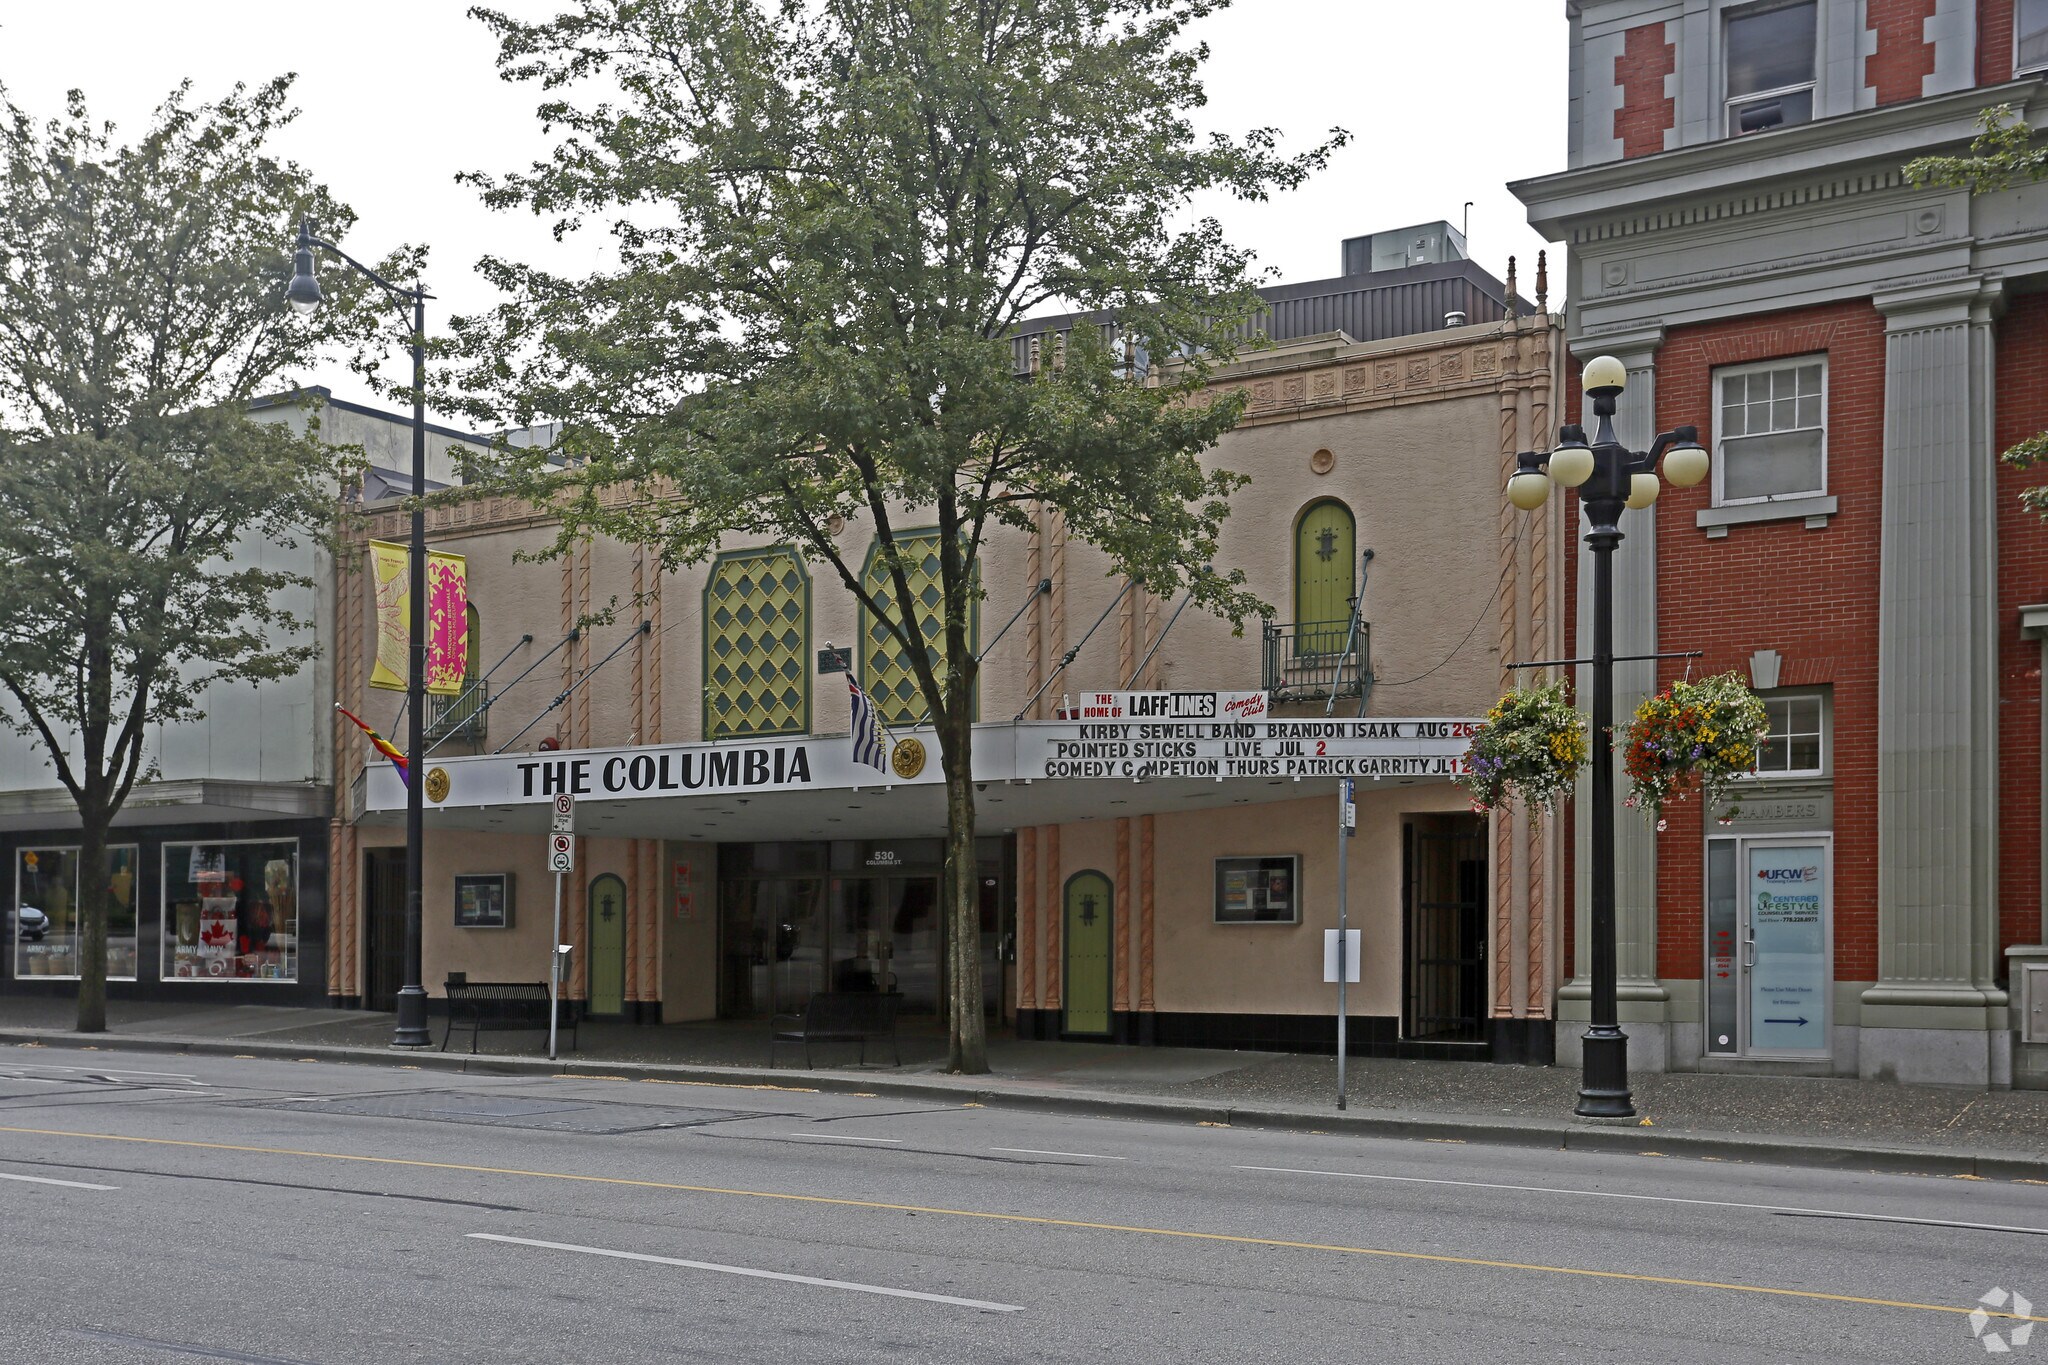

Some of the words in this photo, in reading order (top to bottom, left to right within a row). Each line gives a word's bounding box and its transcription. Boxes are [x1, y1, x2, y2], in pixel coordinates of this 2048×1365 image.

[1095, 694, 1112, 705] THE
[1224, 693, 1263, 713] Comedy
[1084, 707, 1109, 718] HOME
[1111, 707, 1123, 718] OF
[1241, 703, 1265, 718] Club
[1079, 724, 1132, 739] KIRBY
[1139, 724, 1205, 739] SEWELL
[1211, 724, 1256, 739] BAND
[1267, 723, 1345, 738] BRANDON
[1352, 723, 1400, 738] ISAAK
[1416, 722, 1448, 737] AUG
[1058, 743, 1129, 758] POINTED
[1133, 742, 1197, 758] STICKS
[1224, 742, 1262, 757] LIVE
[1275, 741, 1304, 757] JUL
[1316, 740, 1327, 756] 2
[517, 759, 591, 797] THE
[602, 747, 811, 792] COLUMBIA
[1045, 761, 1116, 777] COMEDY
[1122, 760, 1219, 779] COMPETION
[1226, 760, 1280, 775] THURS
[1287, 759, 1355, 775] PATRICK
[1358, 759, 1430, 774] GARRITY
[1728, 804, 1816, 819] HAMBERS
[874, 851, 895, 860] 530
[1766, 869, 1802, 880] UFCW
[1773, 895, 1819, 903] CENTERED
[26, 945, 46, 953] ARMY
[51, 945, 70, 953] NAVY
[176, 945, 198, 954] ARMY
[204, 945, 224, 954] NAVY
